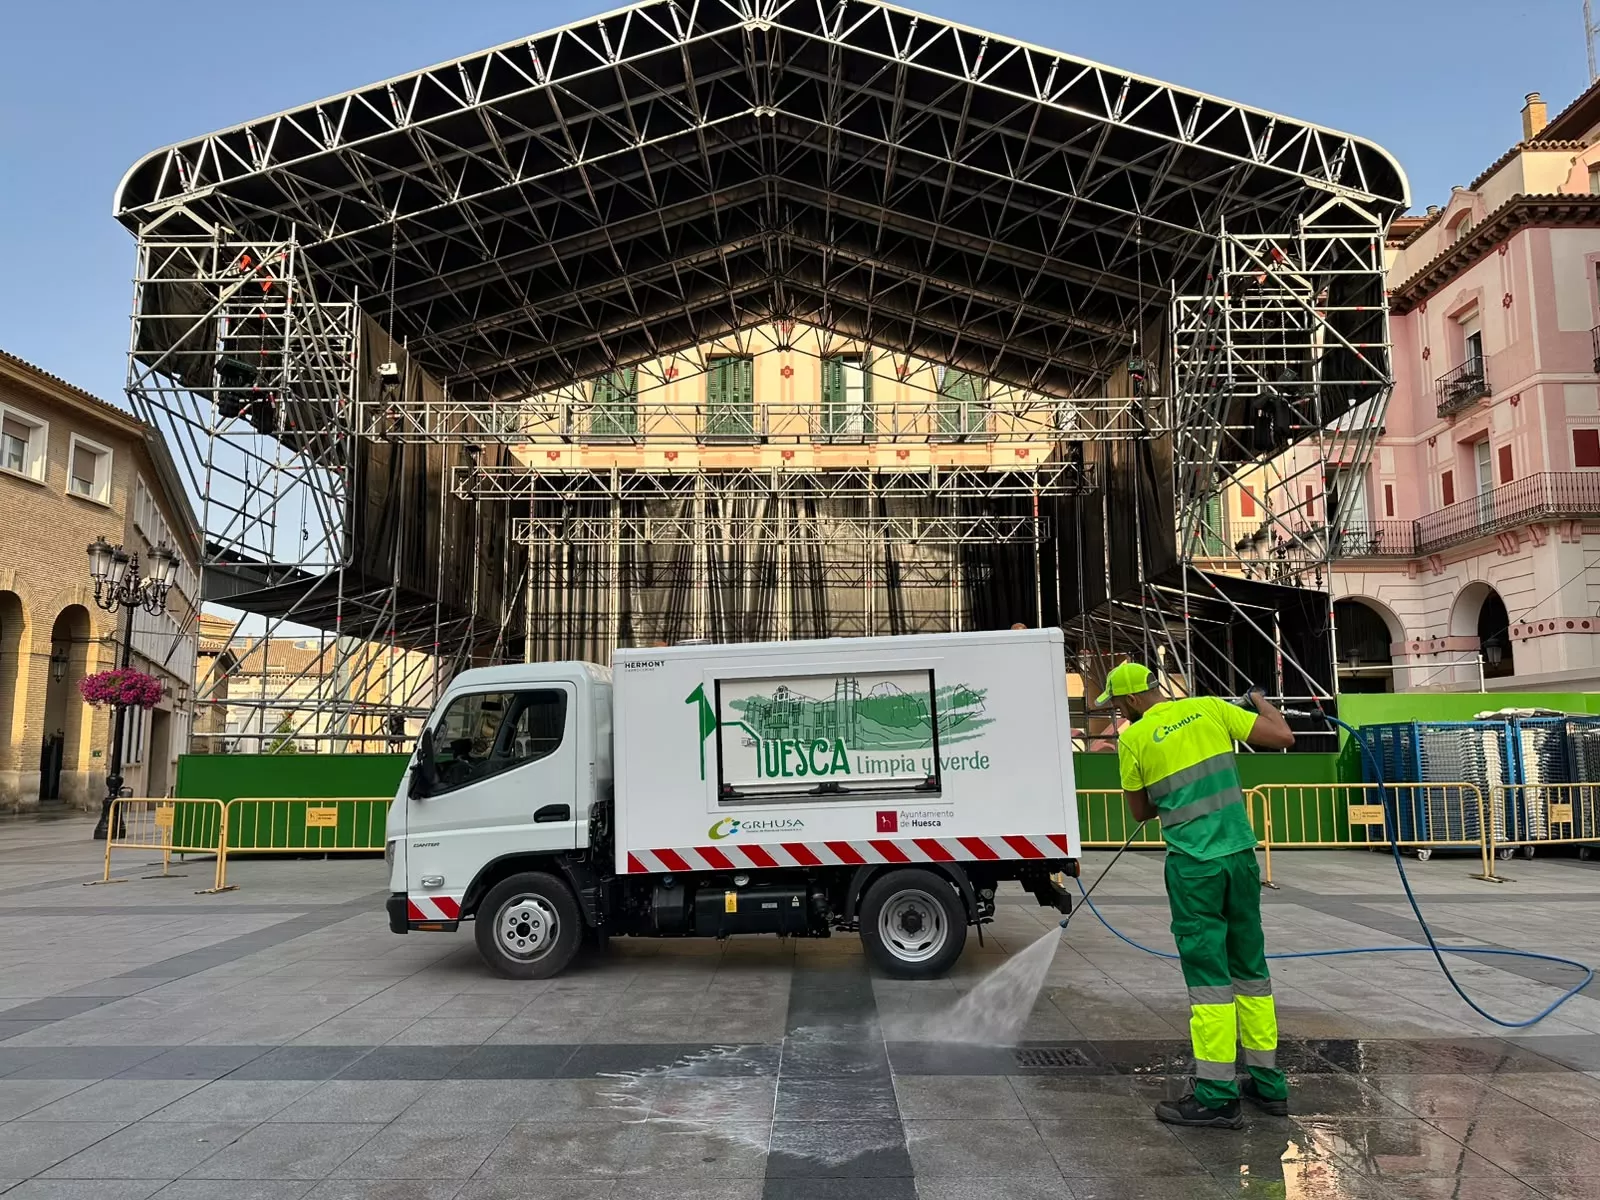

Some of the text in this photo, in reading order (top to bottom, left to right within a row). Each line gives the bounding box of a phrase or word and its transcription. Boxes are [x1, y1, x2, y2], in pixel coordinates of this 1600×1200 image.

[1167, 713, 1202, 731] GRHUSA
[922, 757, 932, 777] y
[939, 750, 990, 772] verde
[900, 810, 954, 820] Ayuntamiento
[741, 819, 804, 829] GRHUSA
[900, 819, 941, 828] de Huesca
